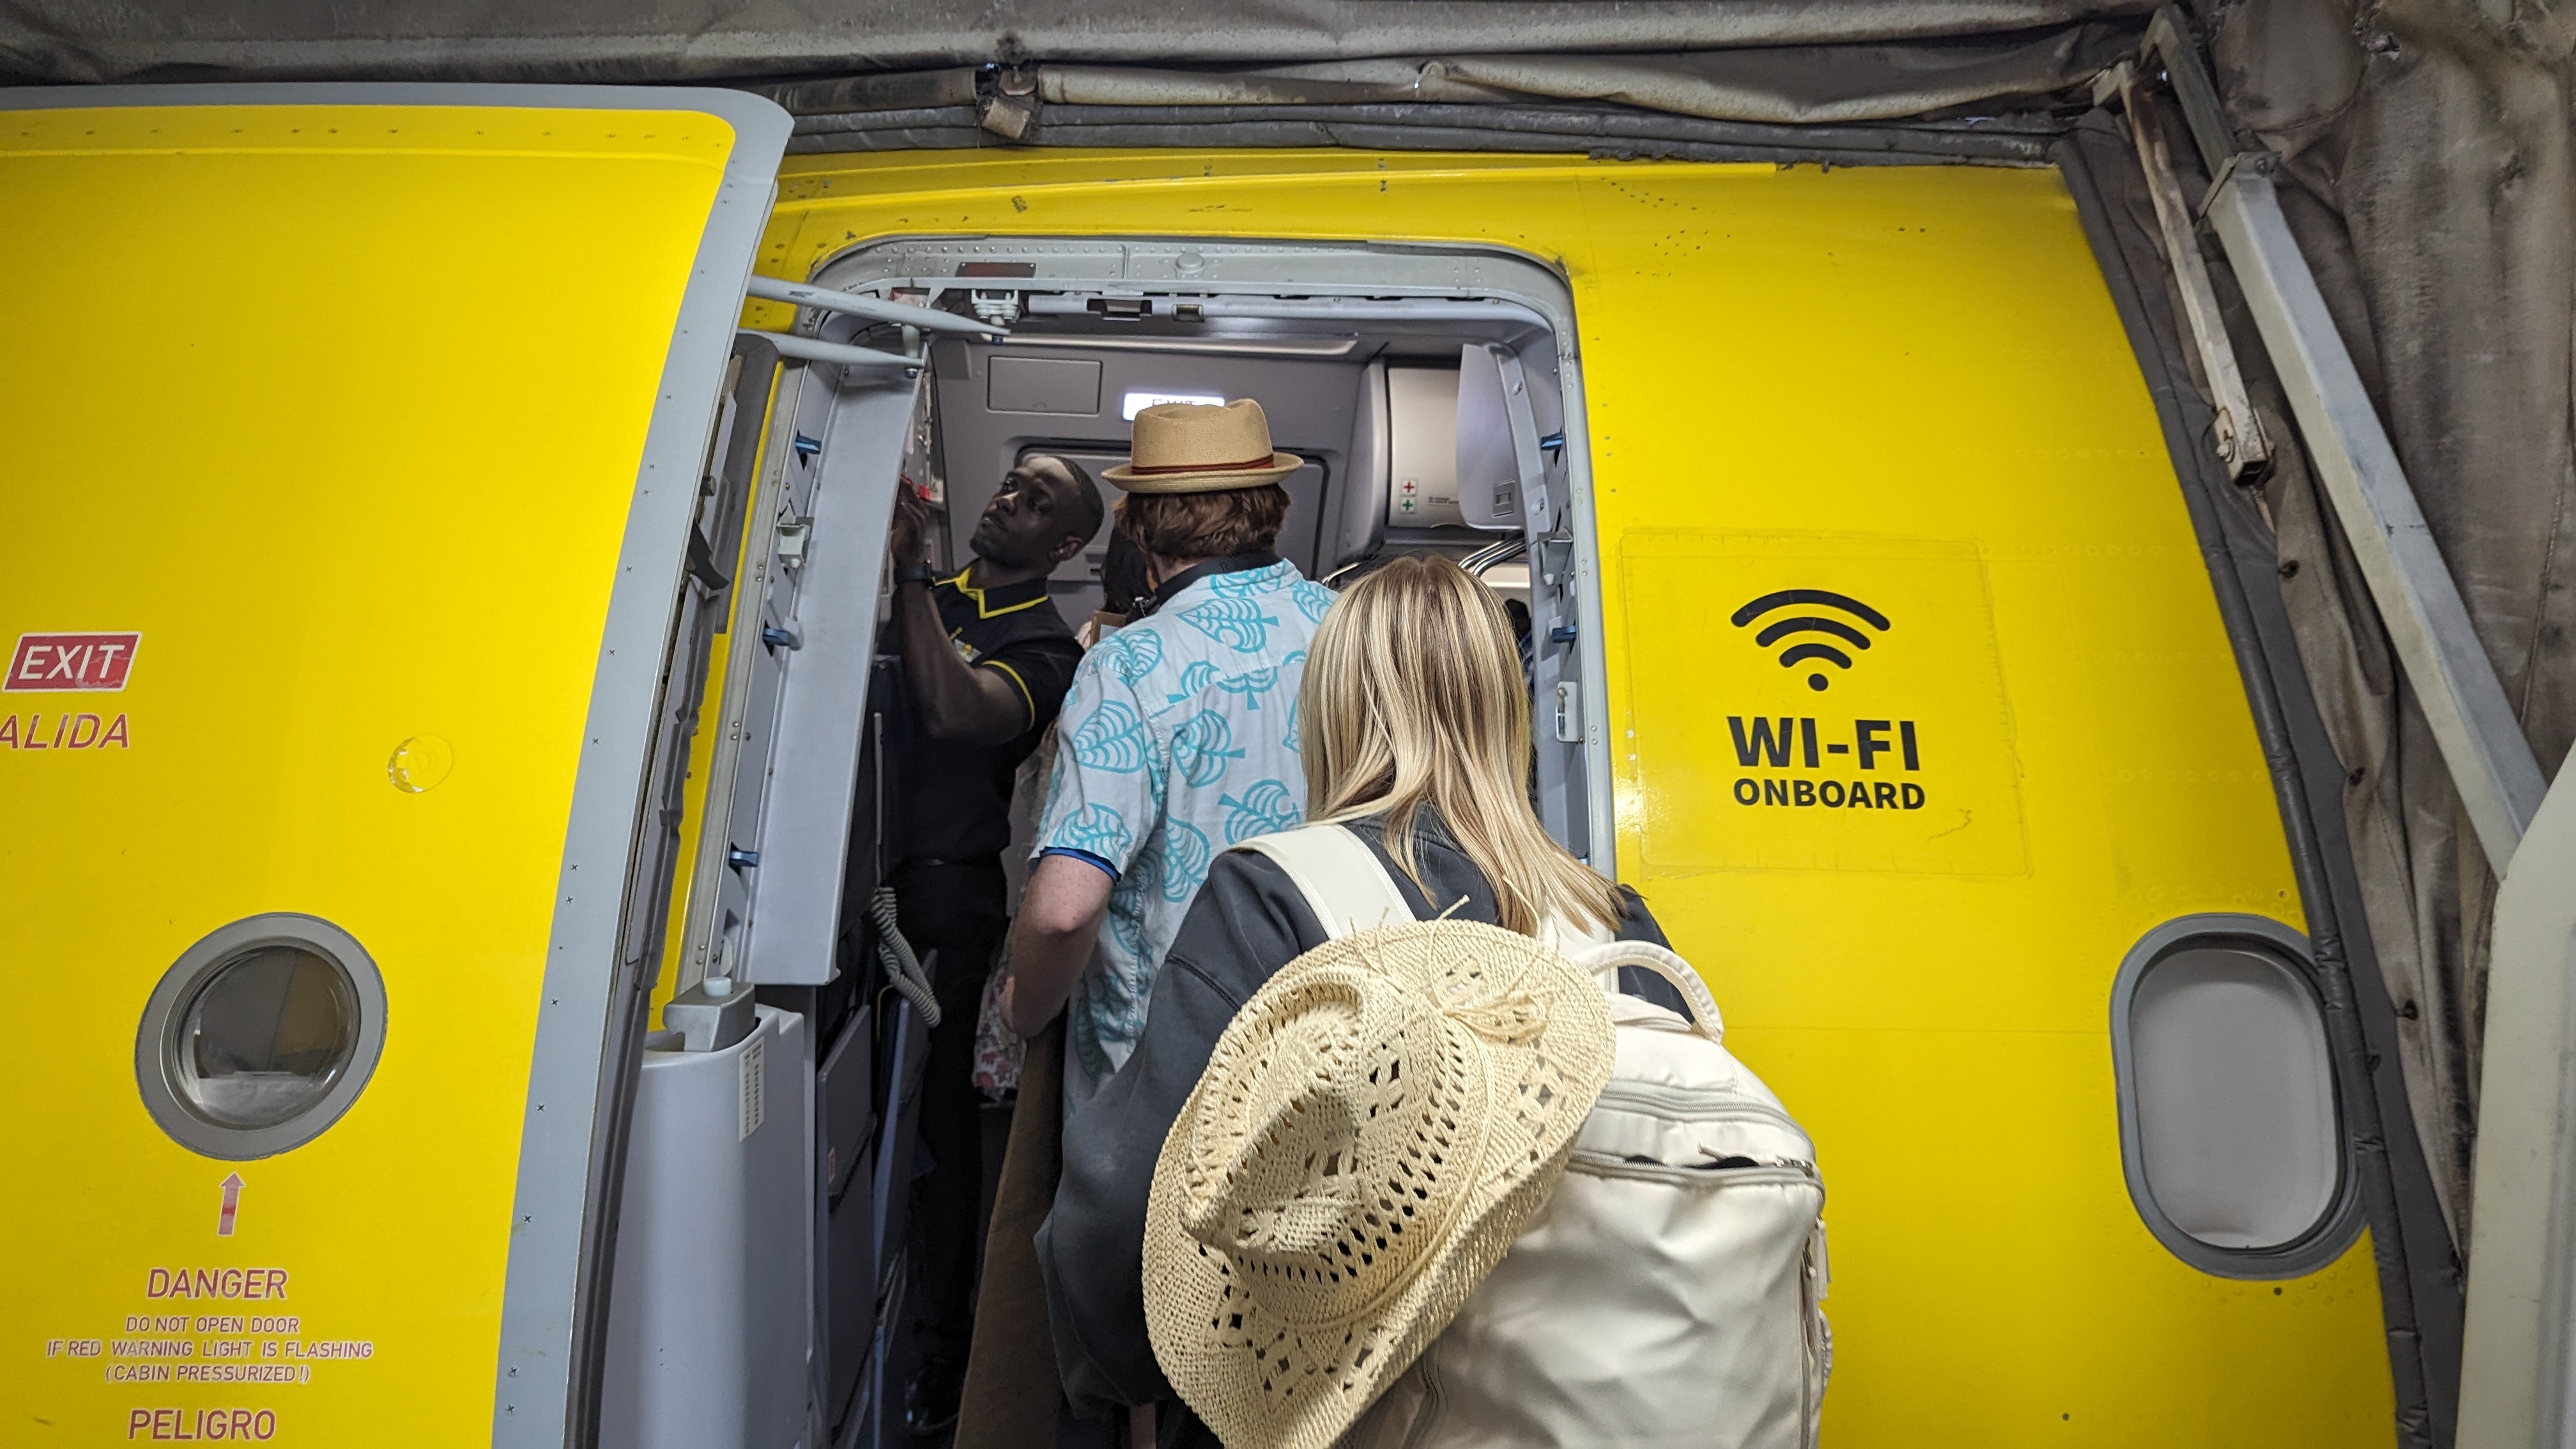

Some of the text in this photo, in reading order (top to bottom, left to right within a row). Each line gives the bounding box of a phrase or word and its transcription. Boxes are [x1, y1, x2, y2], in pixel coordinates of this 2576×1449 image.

[19, 645, 125, 679] EXIT
[0, 714, 129, 749] ALIDA
[1727, 716, 1920, 771] WI-FI
[1733, 778, 1926, 810] ONBOARD
[147, 1268, 288, 1300] DANGER
[125, 1316, 300, 1333] DO NOT OPEN DOOR
[47, 1340, 373, 1358] IF RED WARNING LIGHT IS FLASHING
[105, 1365, 170, 1381] (CABIN
[128, 1409, 277, 1440] PELIGRO
